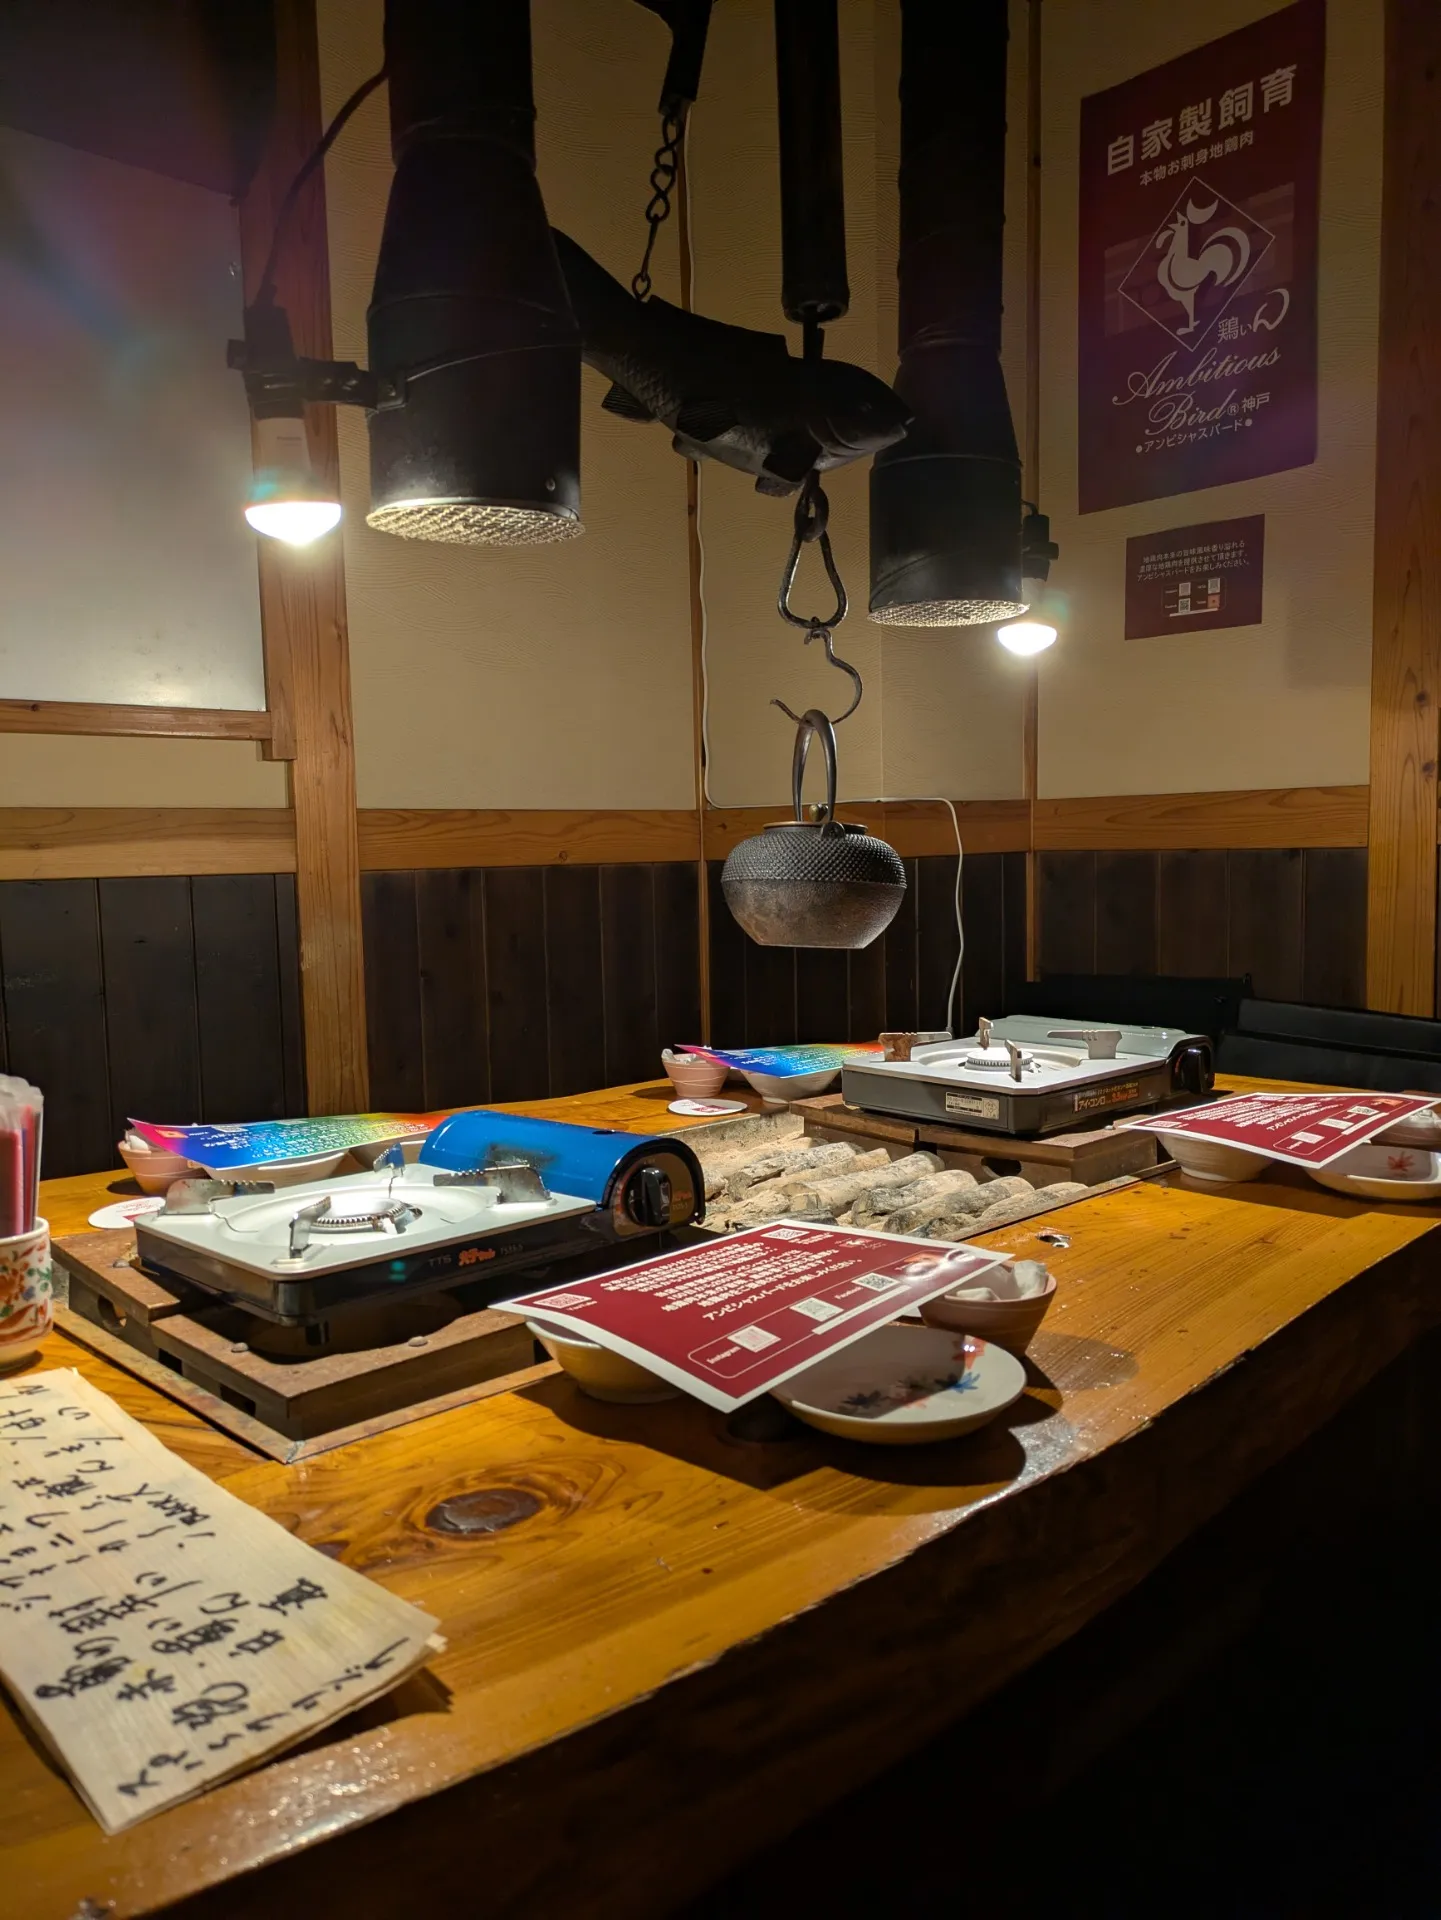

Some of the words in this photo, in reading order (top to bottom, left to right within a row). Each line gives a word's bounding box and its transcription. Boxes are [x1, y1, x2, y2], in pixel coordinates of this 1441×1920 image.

[1107, 63, 1297, 176] 自家製飼育
[1112, 347, 1281, 406] Ambitious
